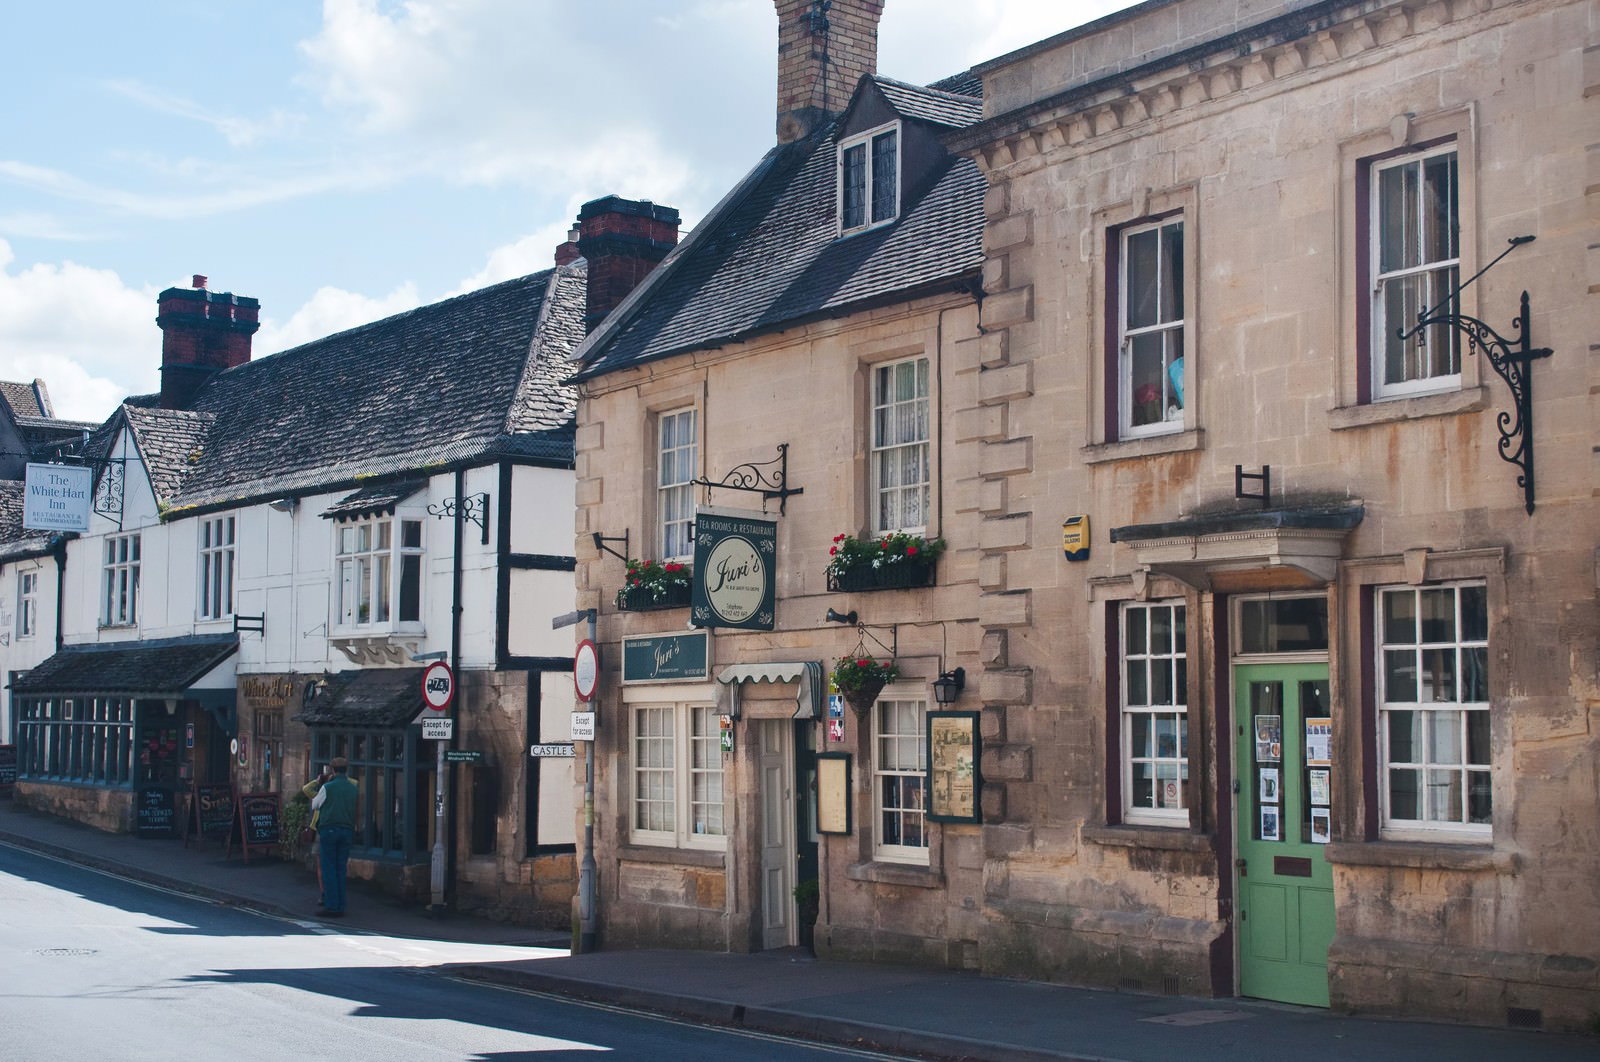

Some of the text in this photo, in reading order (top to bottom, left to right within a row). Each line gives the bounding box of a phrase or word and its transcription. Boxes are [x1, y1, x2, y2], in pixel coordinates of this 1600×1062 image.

[48, 474, 69, 485] The
[31, 485, 85, 499] White Hart
[49, 499, 66, 510] Inn
[699, 519, 775, 536] TEA ROOMS & RESTAURANT
[423, 720, 452, 729] Except for
[532, 747, 567, 756] CASTLE
